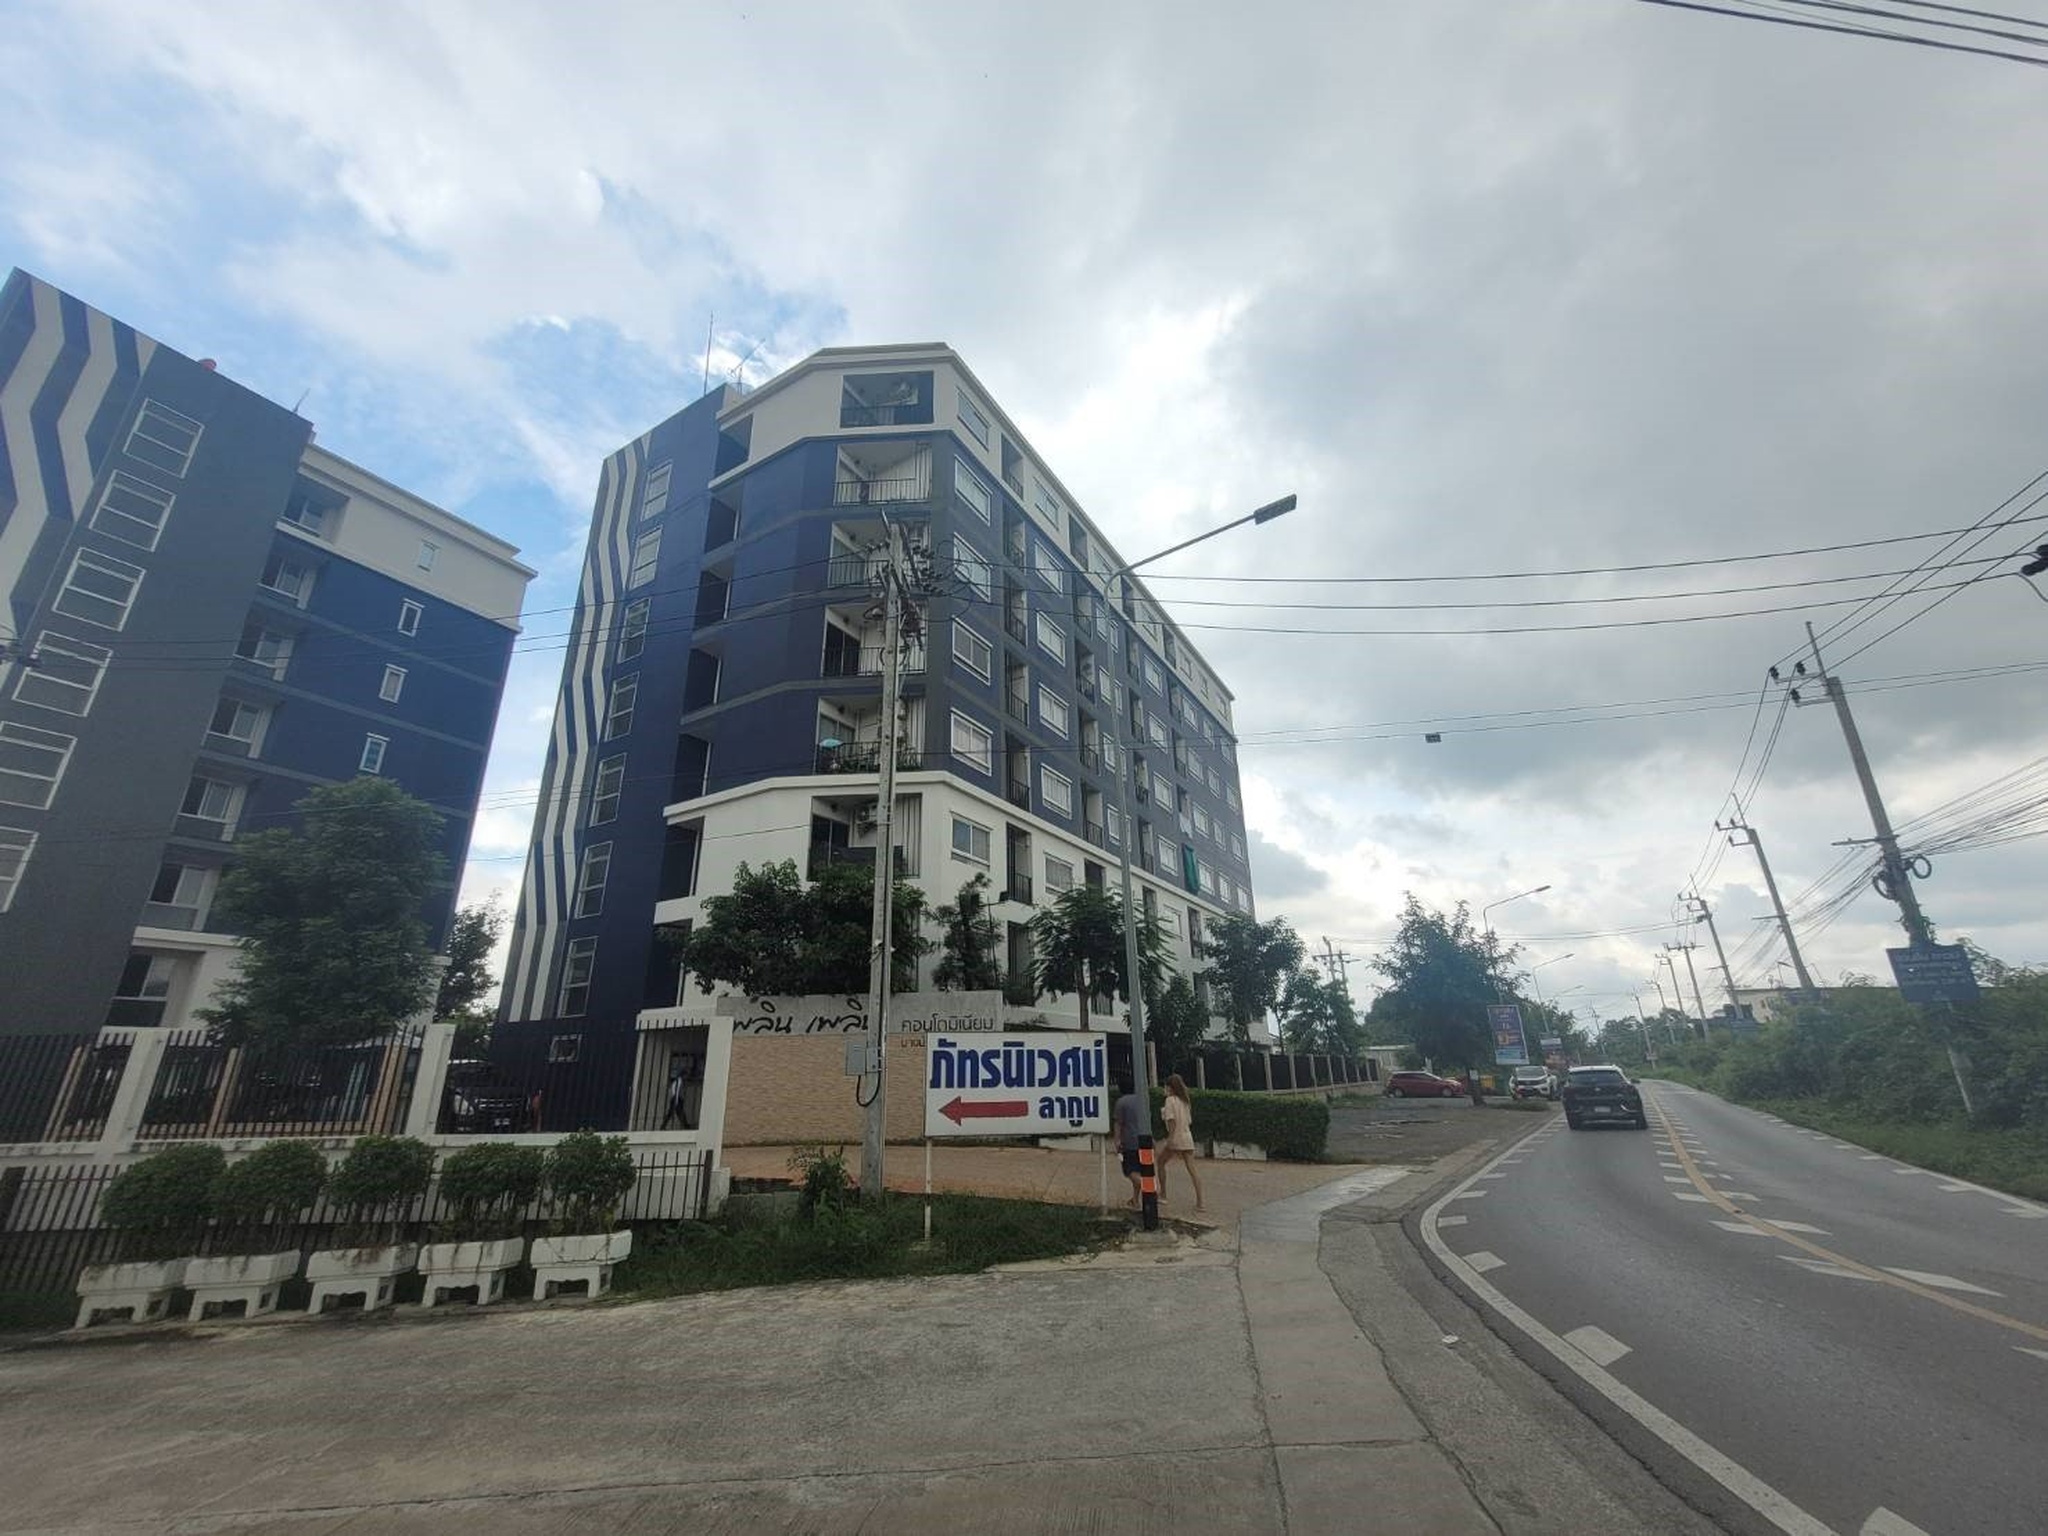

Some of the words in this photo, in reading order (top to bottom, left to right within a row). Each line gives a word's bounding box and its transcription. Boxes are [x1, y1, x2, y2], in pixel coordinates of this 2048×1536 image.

[733, 1000, 792, 1034] พลิน
[929, 1038, 1105, 1089] ภัทรนิเวศน์
[1038, 1095, 1099, 1128] ลากูน
